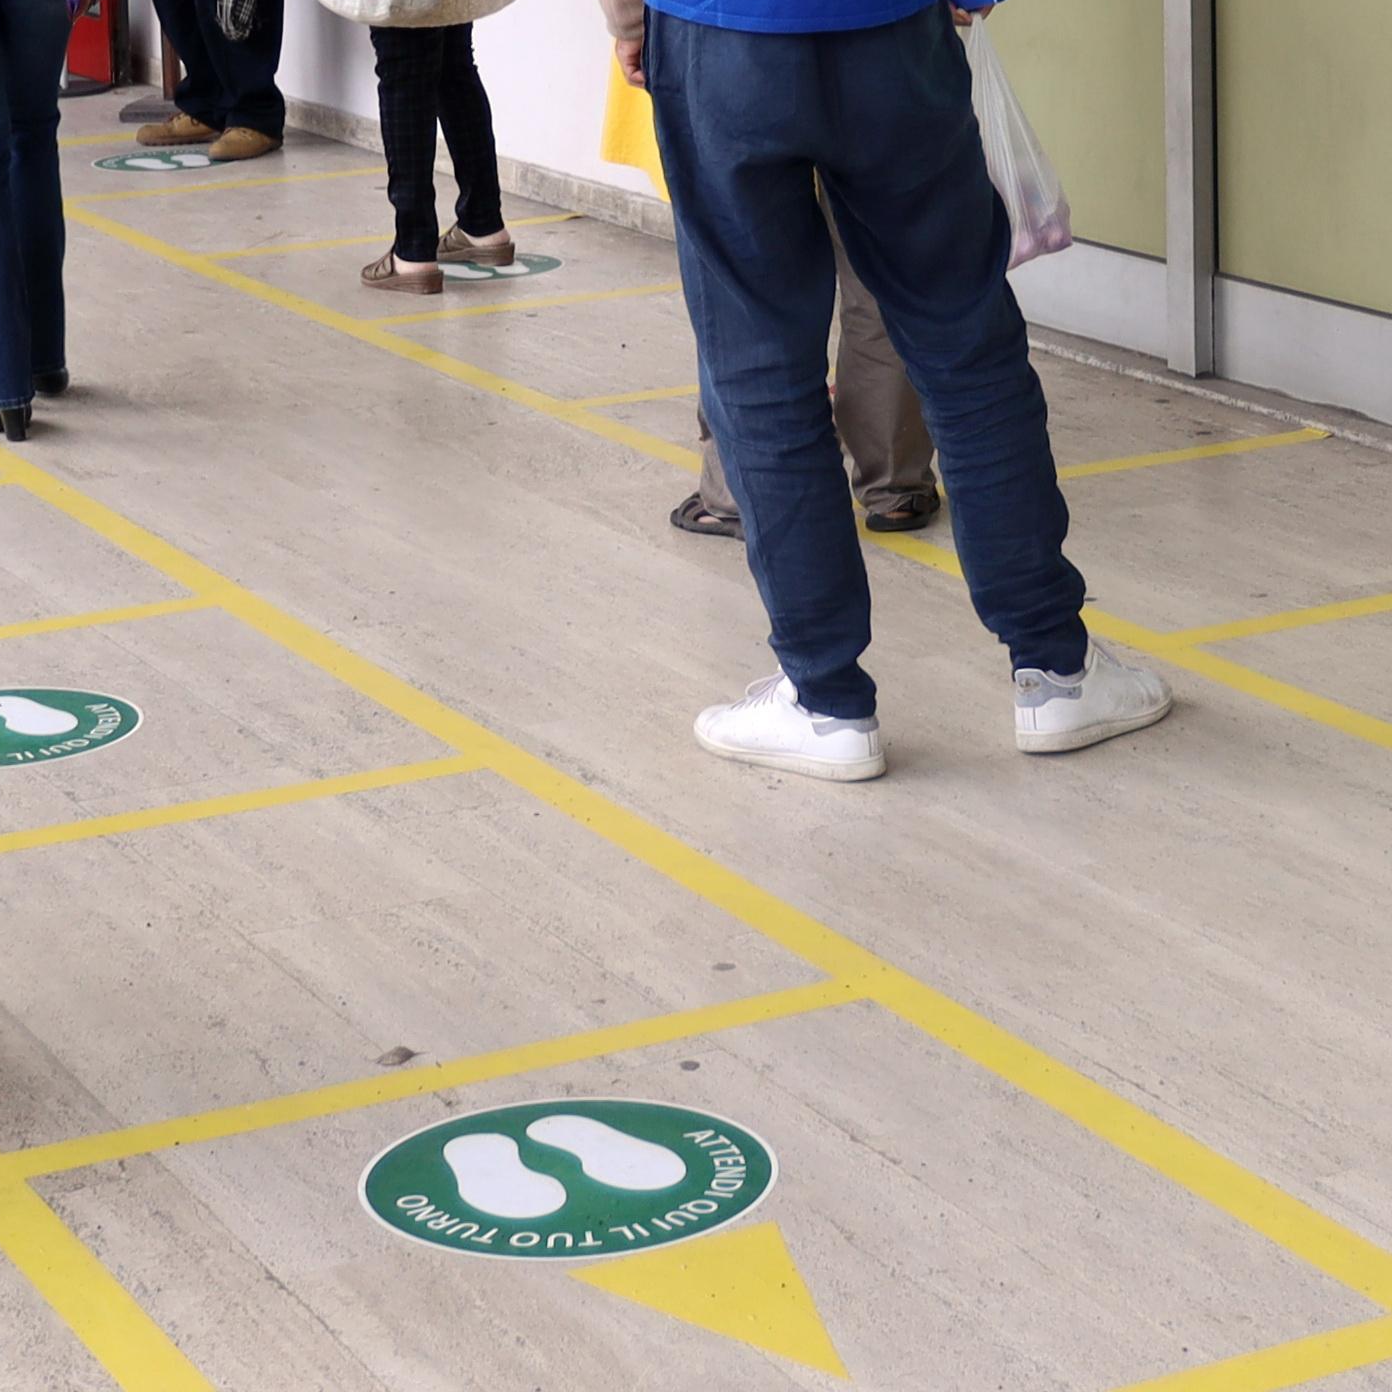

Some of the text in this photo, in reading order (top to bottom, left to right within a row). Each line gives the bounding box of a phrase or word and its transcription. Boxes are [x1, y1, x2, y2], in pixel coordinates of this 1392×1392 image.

[6, 751, 35, 761] IL
[39, 738, 90, 756] QUI
[395, 1129, 747, 1249] ATTENDI QUI IL TUO TURNO
